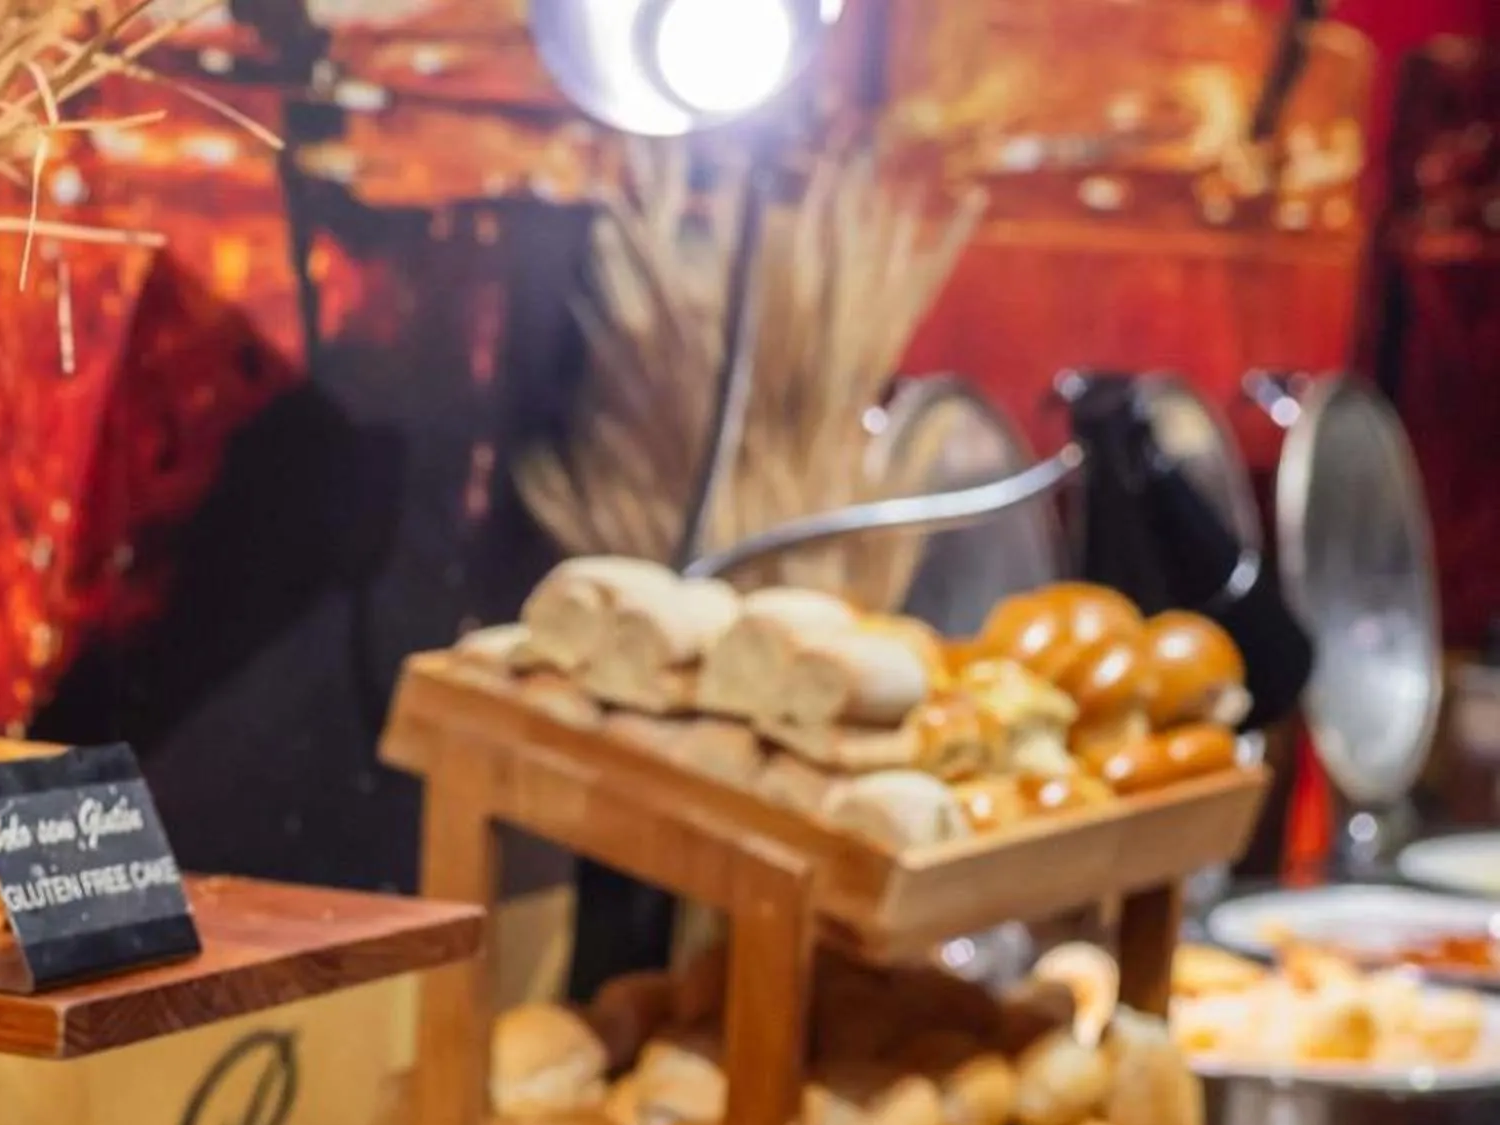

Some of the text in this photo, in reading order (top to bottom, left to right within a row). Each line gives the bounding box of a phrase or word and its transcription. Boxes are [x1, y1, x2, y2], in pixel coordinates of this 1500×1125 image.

[4, 856, 181, 912] GLUTEN FREE CAKE
